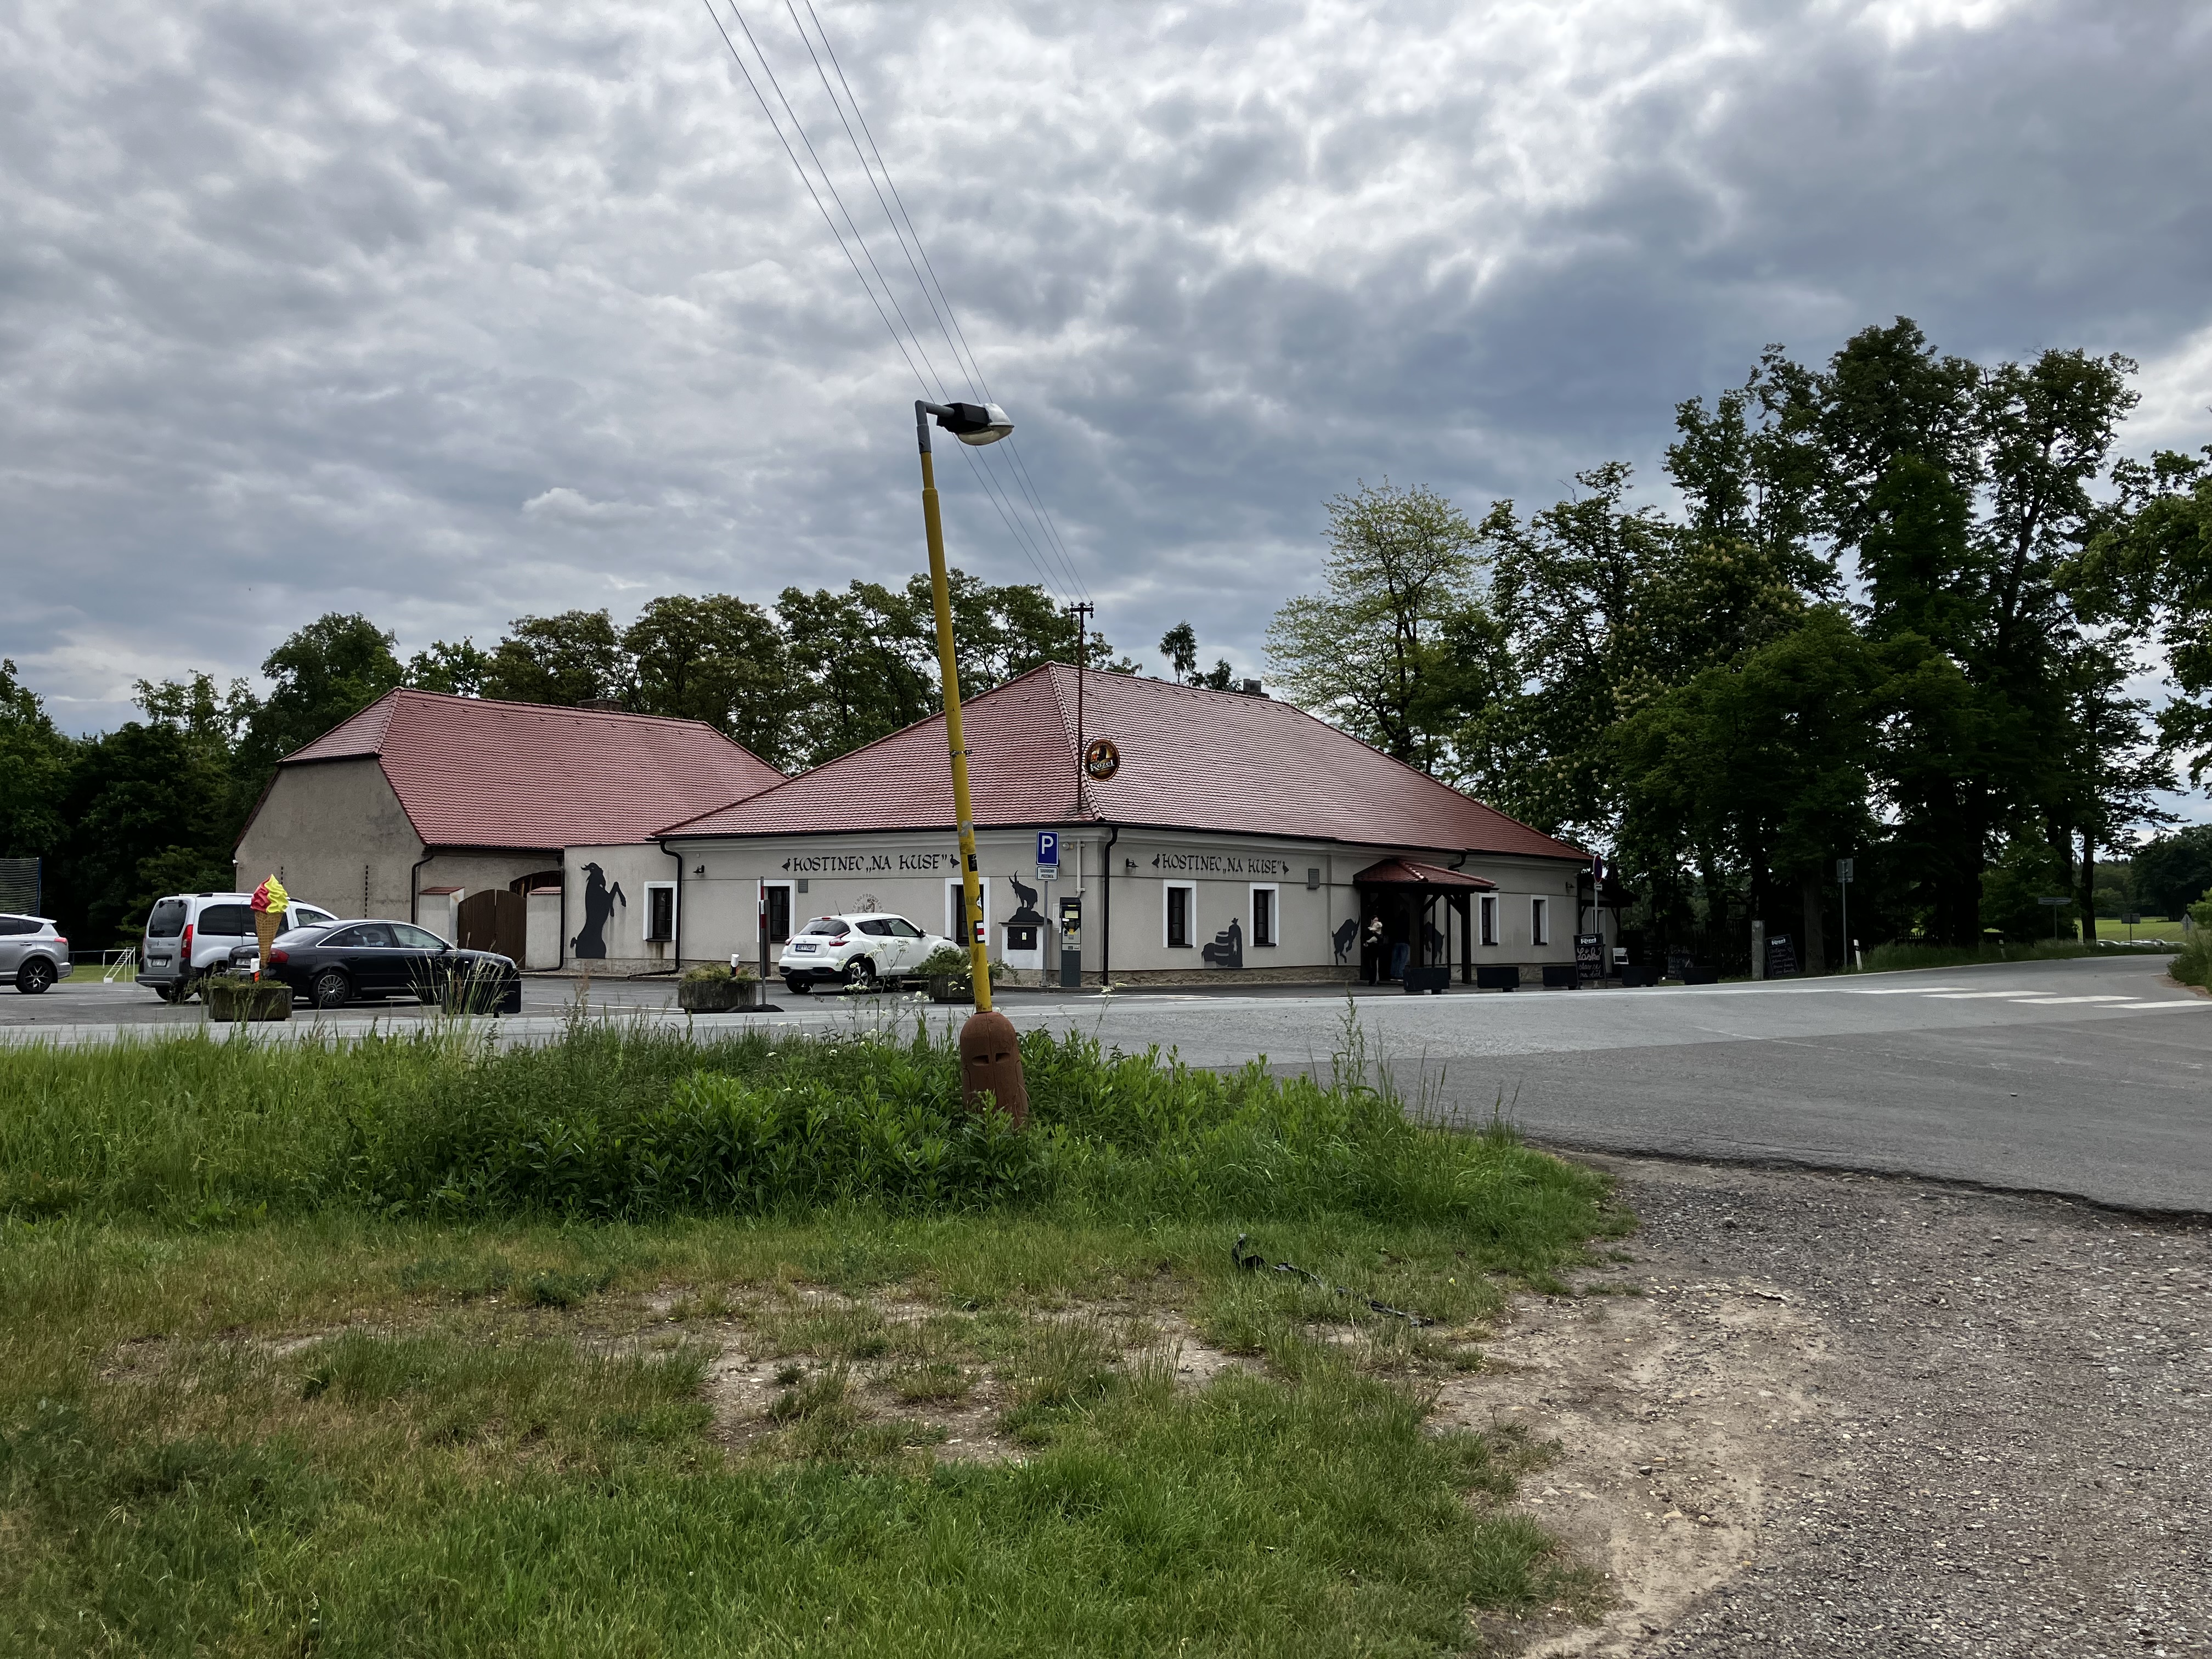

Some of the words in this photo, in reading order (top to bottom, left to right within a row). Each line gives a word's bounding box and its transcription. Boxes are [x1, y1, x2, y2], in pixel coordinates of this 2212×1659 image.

[1090, 759, 1115, 772] Kozel
[1041, 835, 1054, 854] P
[793, 856, 864, 871] HOSTINEC
[1162, 853, 1222, 871] HOSTINEC
